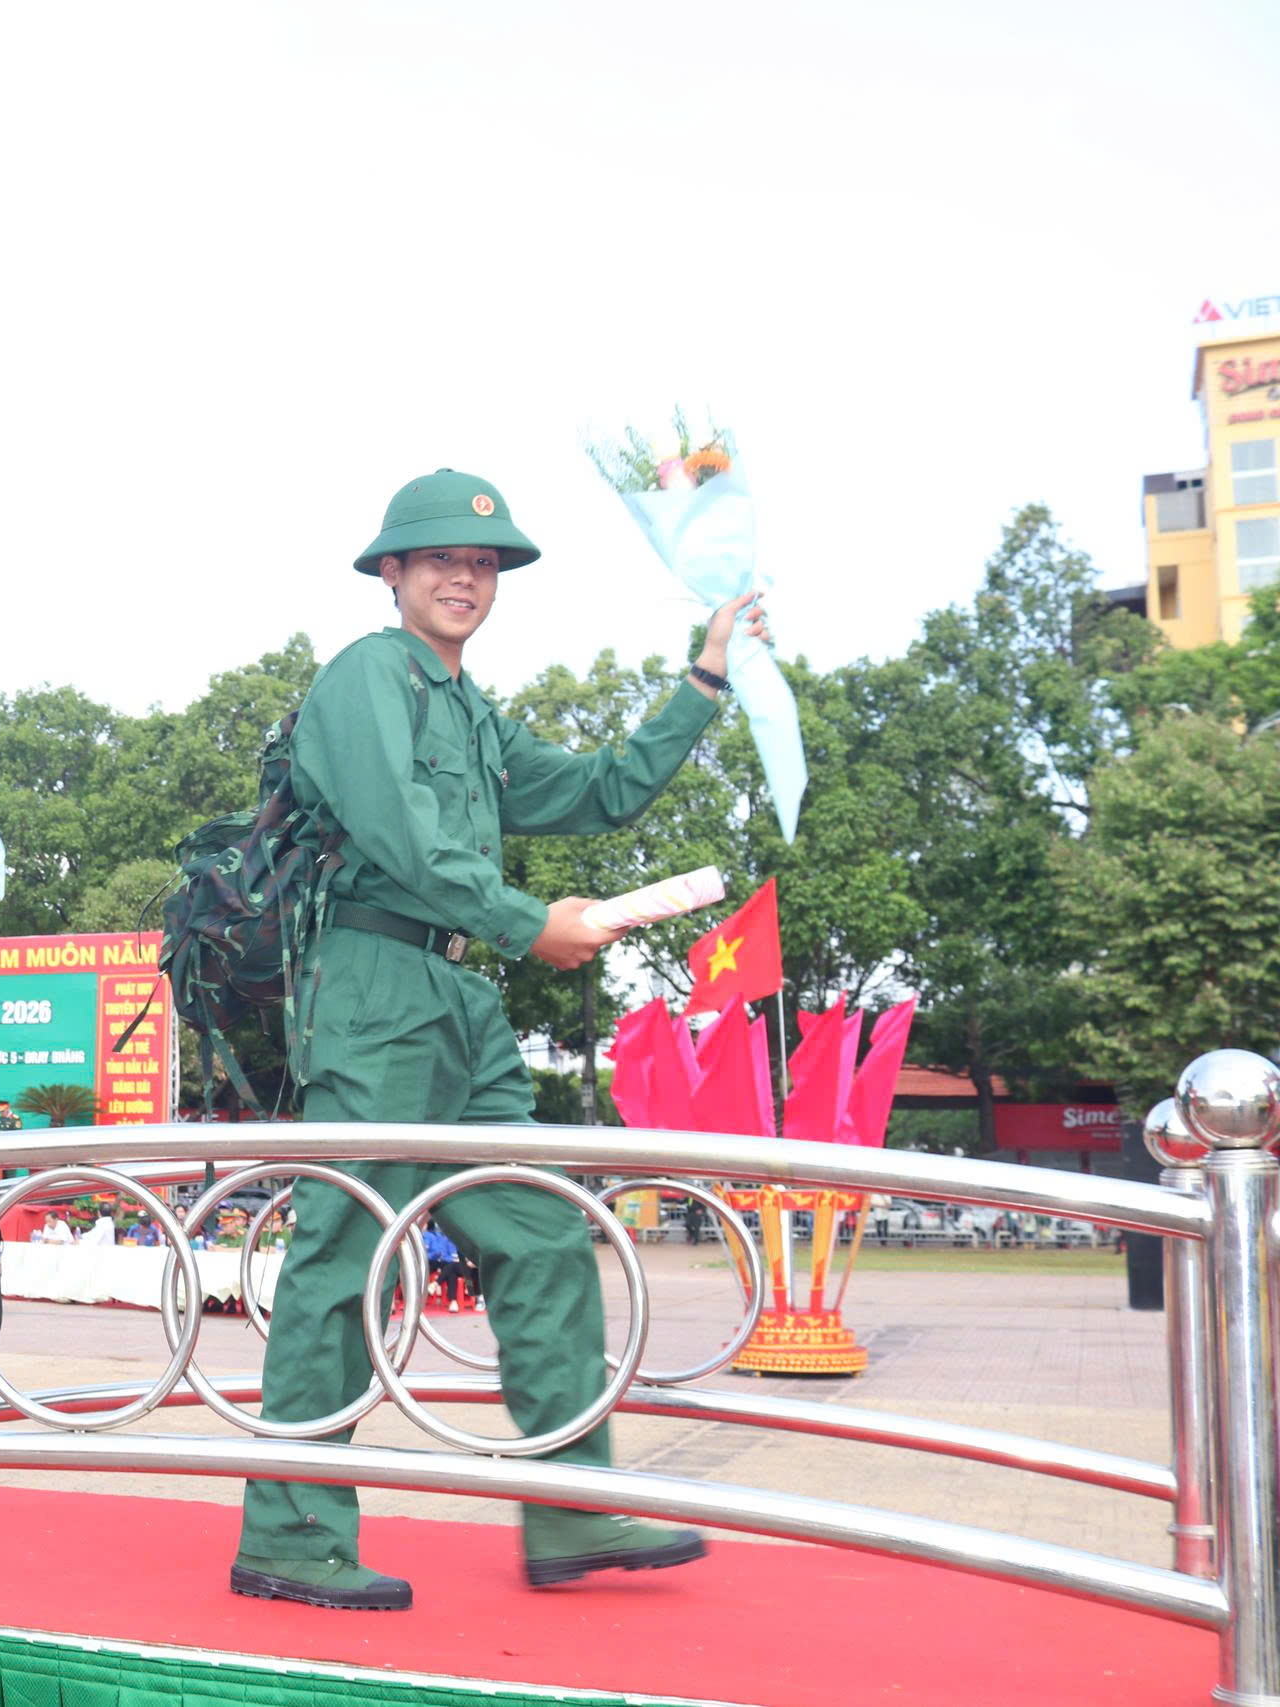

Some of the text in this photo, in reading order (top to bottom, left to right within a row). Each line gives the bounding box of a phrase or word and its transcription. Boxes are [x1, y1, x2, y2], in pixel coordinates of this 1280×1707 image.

[26, 941, 96, 967] MUÔN
[103, 940, 157, 965] NĂM
[0, 999, 52, 1025] 2026
